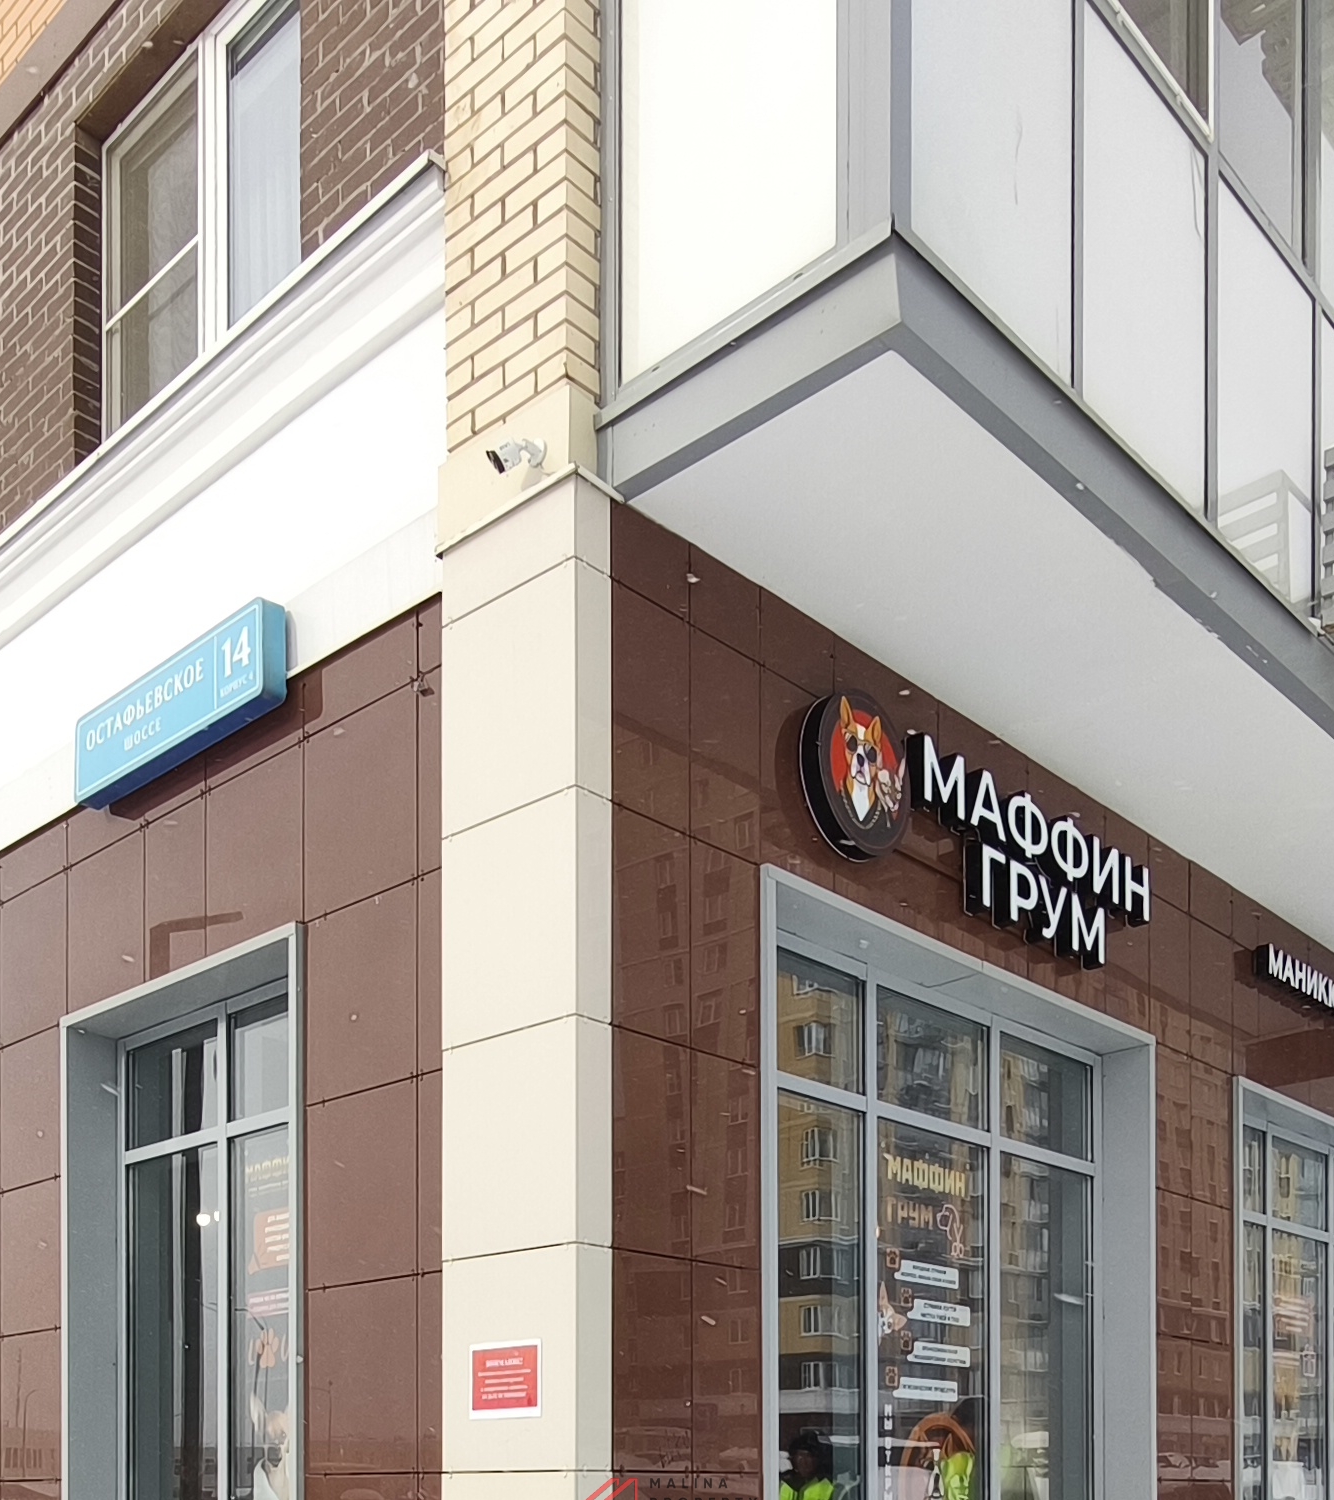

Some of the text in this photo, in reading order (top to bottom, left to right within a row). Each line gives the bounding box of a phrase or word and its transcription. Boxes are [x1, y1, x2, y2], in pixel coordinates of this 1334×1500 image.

[221, 625, 252, 679] 14
[85, 656, 205, 751] ОСТАФЬЕВСКОЕ
[123, 716, 162, 751] ШОССЕ
[923, 734, 1151, 923] МАФФИН
[981, 842, 1106, 965] ГРУМ
[886, 1155, 966, 1198] МАФФИН
[886, 1196, 934, 1231] ГРУМ
